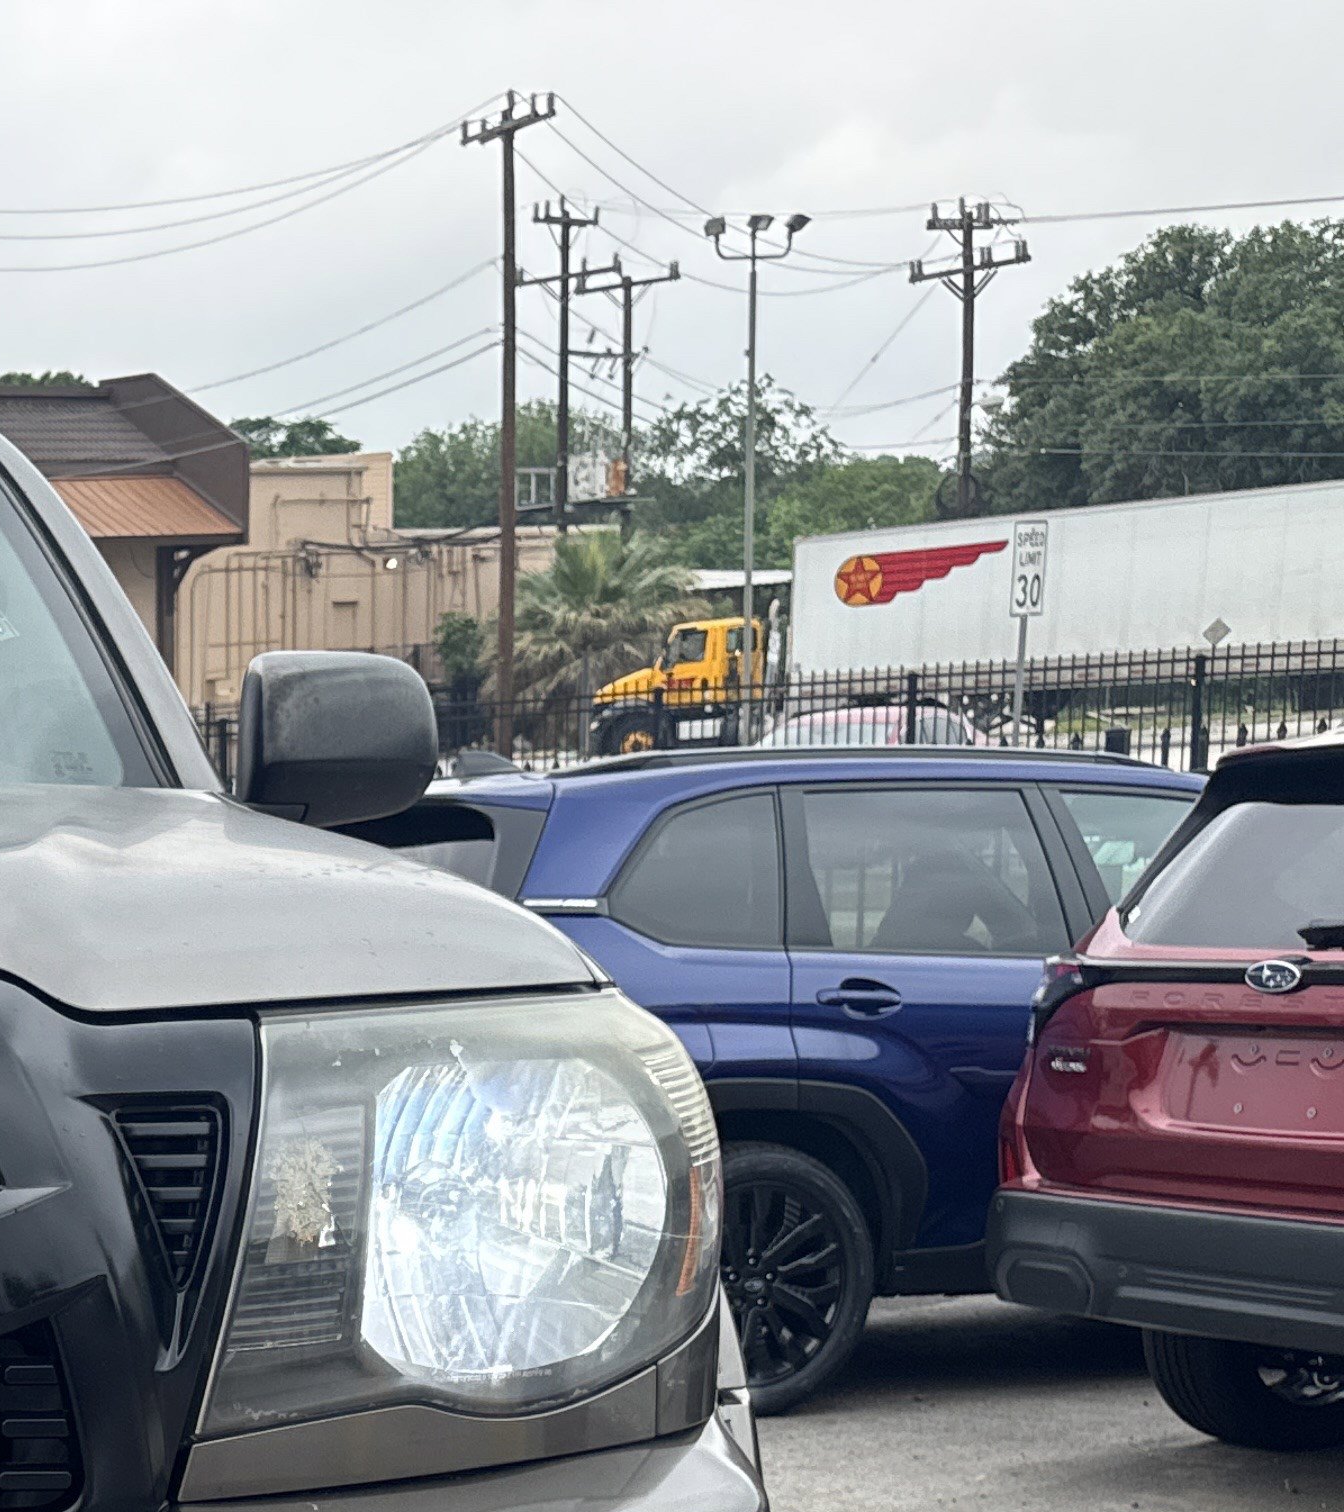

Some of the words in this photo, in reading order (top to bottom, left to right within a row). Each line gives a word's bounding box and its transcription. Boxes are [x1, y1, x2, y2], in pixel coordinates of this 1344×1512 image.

[1017, 530, 1045, 547] SPEED
[1019, 551, 1042, 567] LIMIT
[1015, 573, 1041, 608] 30
